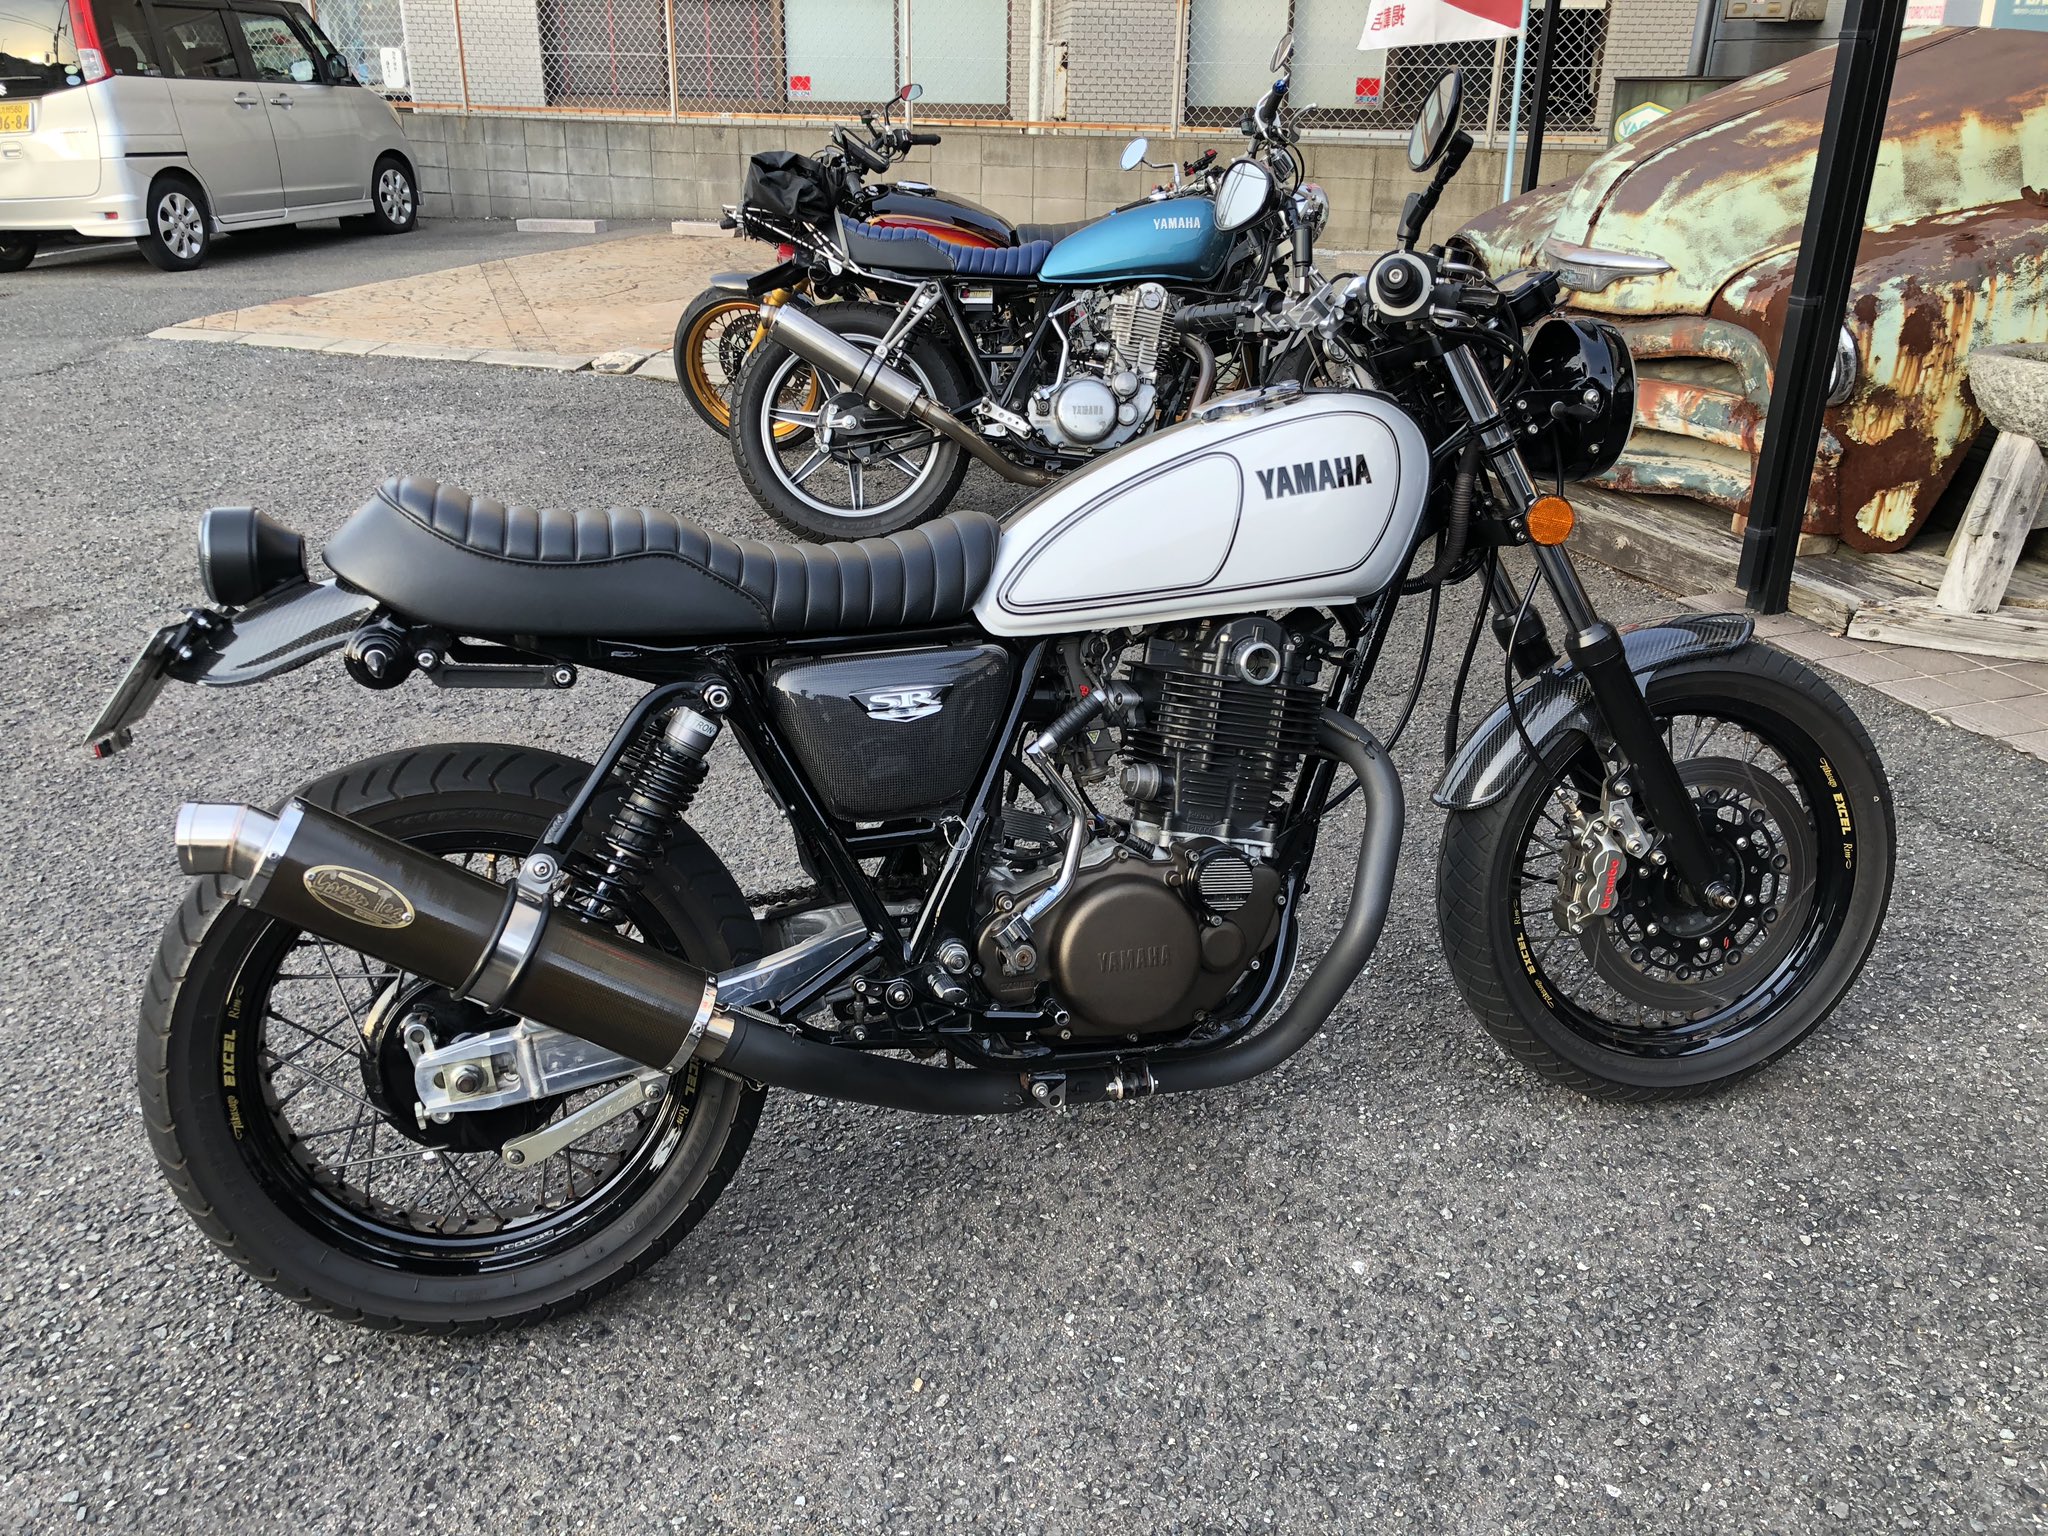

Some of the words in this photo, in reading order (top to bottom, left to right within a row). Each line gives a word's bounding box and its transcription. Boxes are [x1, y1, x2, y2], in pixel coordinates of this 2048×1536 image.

[1153, 217, 1201, 230] YAMAHA
[1072, 405, 1104, 416] YAMAHA
[1255, 454, 1372, 500] YAMAHA
[866, 690, 942, 711] SR
[1833, 793, 1851, 836] EXCEL
[1843, 843, 1853, 869] Rim
[1600, 859, 1620, 909] brembo
[1096, 945, 1169, 973] YAMAHA
[1517, 932, 1536, 975] EXCEL
[222, 1029, 236, 1087] EXCEL
[676, 1104, 690, 1125] Rim
